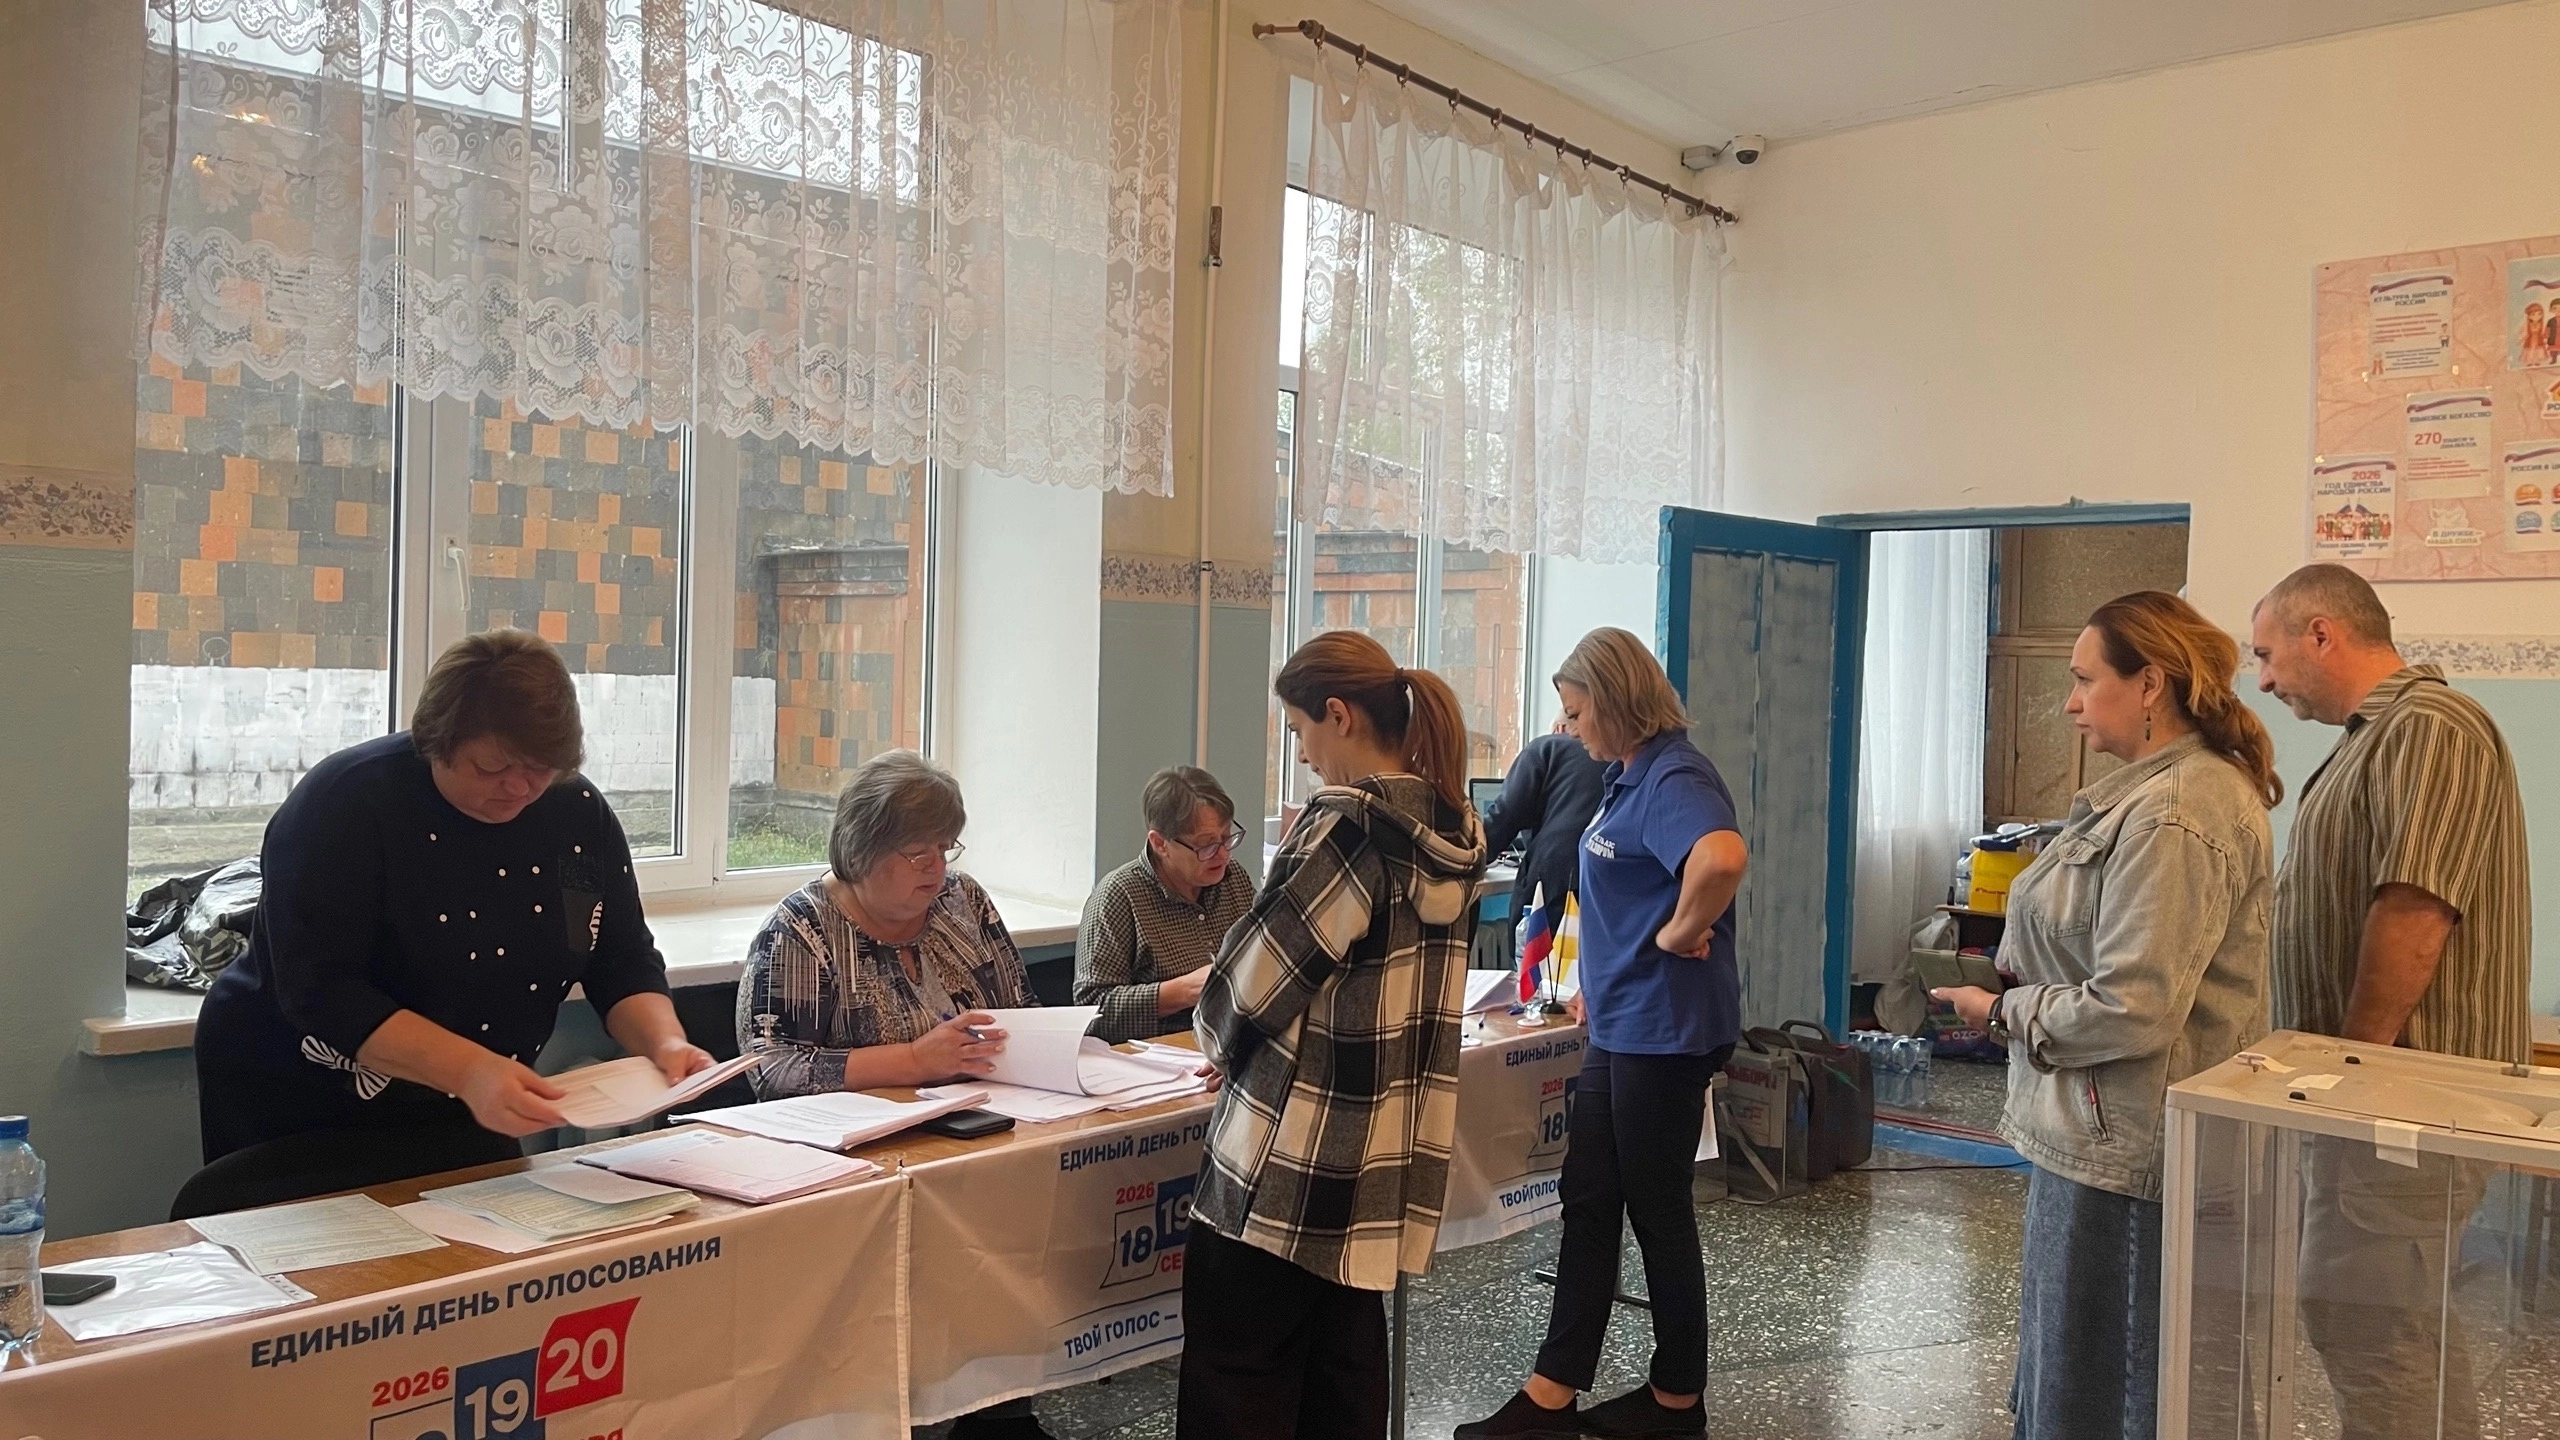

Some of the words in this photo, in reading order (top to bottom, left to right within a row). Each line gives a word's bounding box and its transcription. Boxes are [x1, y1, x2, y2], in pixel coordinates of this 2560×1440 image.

[2414, 432, 2442, 446] 270
[2352, 470, 2381, 480] 2026
[1506, 1041, 1553, 1067] ЕДИНЫЙ
[1554, 1039, 1580, 1059] ДЕНЬ
[1541, 1078, 1564, 1096] 2026
[1543, 1111, 1564, 1144] 18
[1060, 1135, 1133, 1172] ЕДИНЫЙ
[1138, 1131, 1180, 1158] ДЕНЬ
[1115, 1181, 1155, 1205] 2026
[1160, 1193, 1193, 1235] 19
[1120, 1225, 1154, 1268] 18
[251, 1305, 405, 1368] ЕДИНЫЙ
[413, 1290, 500, 1335] ДЕНЬ
[507, 1236, 721, 1309] ГОЛОСОВАНИЯ
[1064, 1323, 1102, 1358] ТВОЙ
[1105, 1310, 1160, 1342] ГОЛОС
[545, 1327, 619, 1393] 20
[372, 1366, 450, 1407] 2026
[464, 1378, 530, 1440] 19
